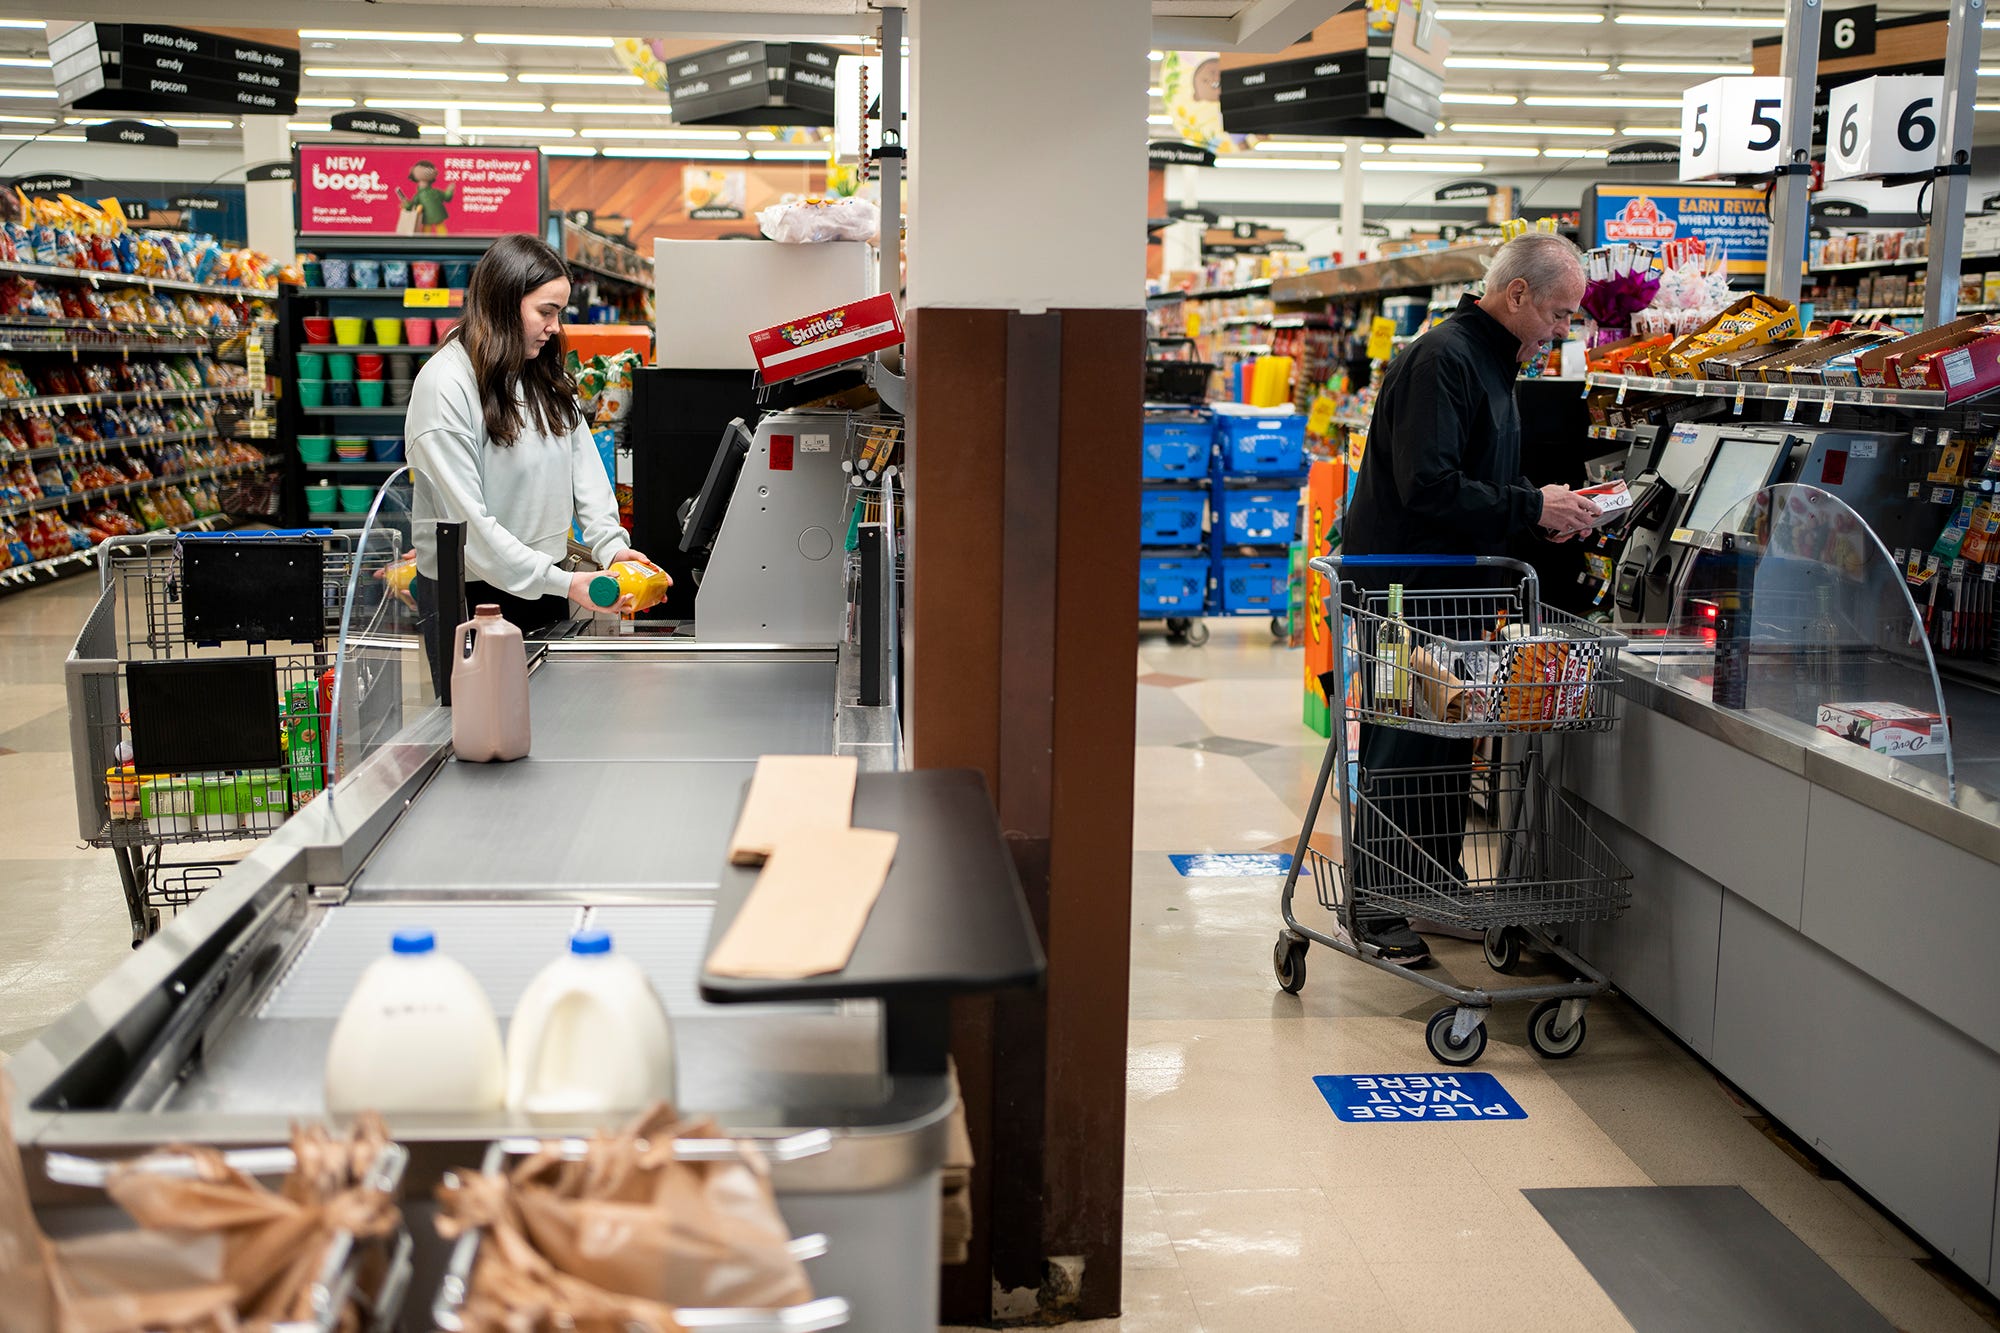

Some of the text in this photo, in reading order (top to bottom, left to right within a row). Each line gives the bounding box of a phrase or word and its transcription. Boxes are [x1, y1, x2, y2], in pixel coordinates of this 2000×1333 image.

[1834, 18, 1855, 49] 6
[143, 32, 198, 52] potato chips
[156, 57, 184, 74] candy
[235, 49, 285, 68] tortilla chips
[1314, 62, 1341, 76] raisins
[150, 79, 188, 94] popcorn
[237, 70, 281, 88] snack nuts
[1242, 71, 1266, 86] cereal
[237, 91, 276, 108] rice cakes
[1274, 87, 1307, 103] seasonal
[351, 118, 401, 135] snack nuts
[1692, 103, 1709, 157] 5
[1747, 99, 1782, 151] 5
[1839, 103, 1858, 157] 6
[1897, 97, 1936, 152] 6
[119, 129, 146, 143] chips
[325, 156, 367, 171] NEW
[444, 157, 532, 172] FREE Delivery &
[312, 166, 381, 191] boost
[444, 170, 461, 182] 2X
[461, 171, 487, 182] Fuel
[21, 178, 71, 192] dry dog food
[127, 203, 144, 219] 11
[1678, 198, 1720, 214] EARN
[1677, 214, 1712, 227] WHEN
[1712, 215, 1737, 227] YOU
[1607, 223, 1673, 237] POWER UP
[791, 317, 843, 346] Skittles
[1861, 371, 1886, 388] Skittles
[1900, 374, 1927, 388] Skittles
[1820, 710, 1842, 723] Dove
[1891, 736, 1928, 751] Dove
[1351, 1076, 1461, 1090] HERE
[1366, 1090, 1474, 1104] WAIT
[1346, 1103, 1510, 1119] PLEASE
